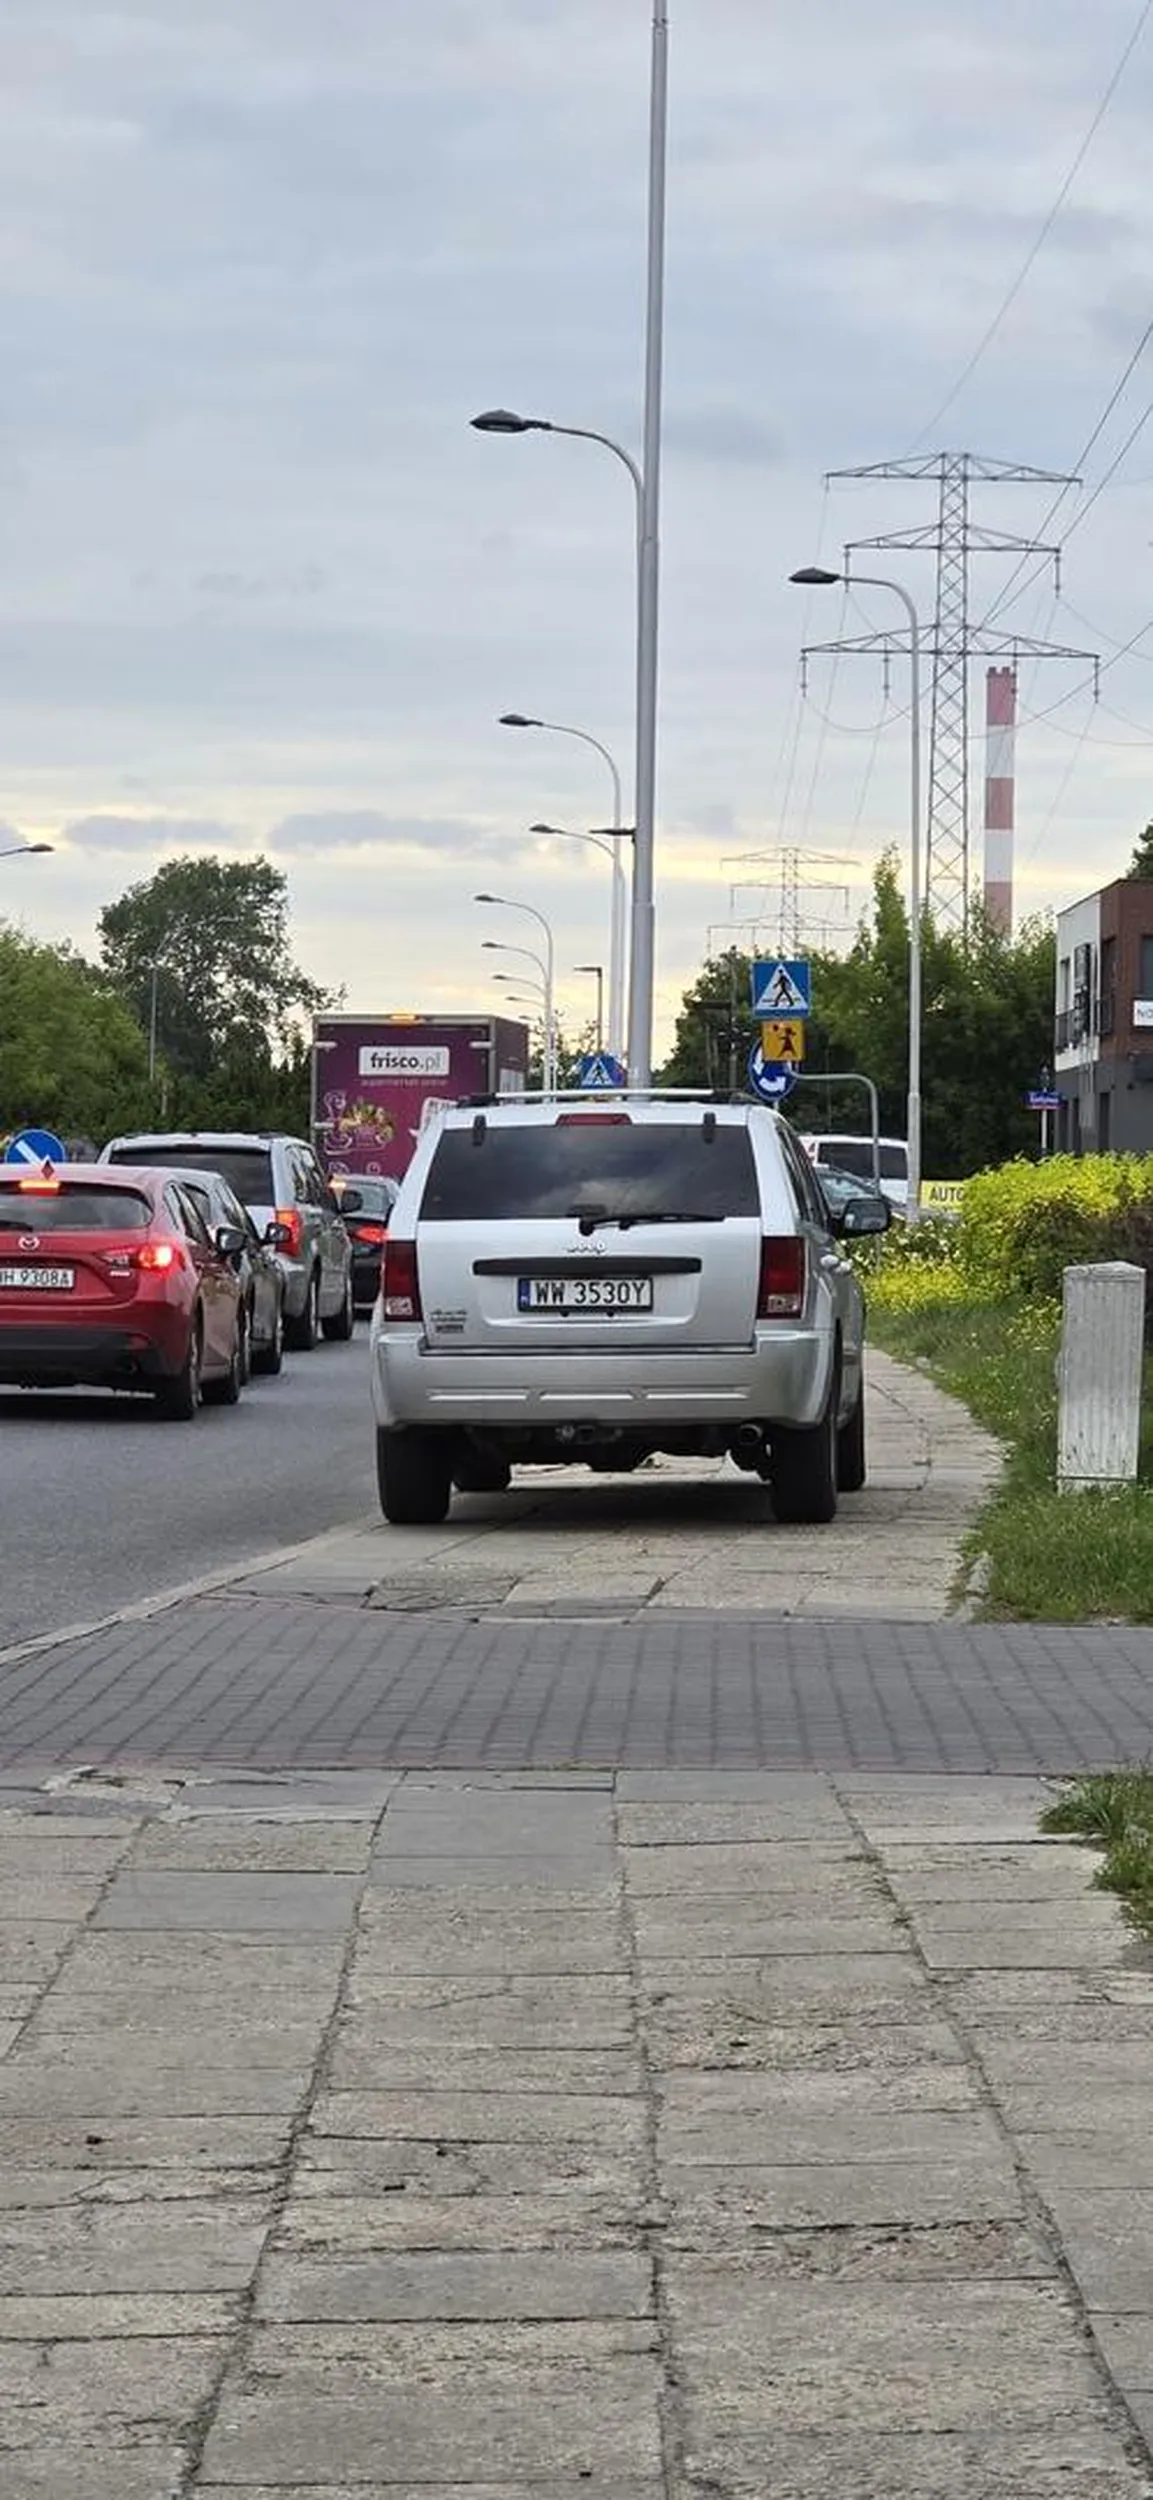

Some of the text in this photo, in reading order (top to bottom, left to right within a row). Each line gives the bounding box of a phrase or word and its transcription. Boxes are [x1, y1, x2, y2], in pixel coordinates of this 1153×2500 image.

[370, 1052, 441, 1071] frisco.pl
[21, 1271, 69, 1285] 9308A
[534, 1282, 566, 1304] WW
[573, 1282, 645, 1304] 3530Y
